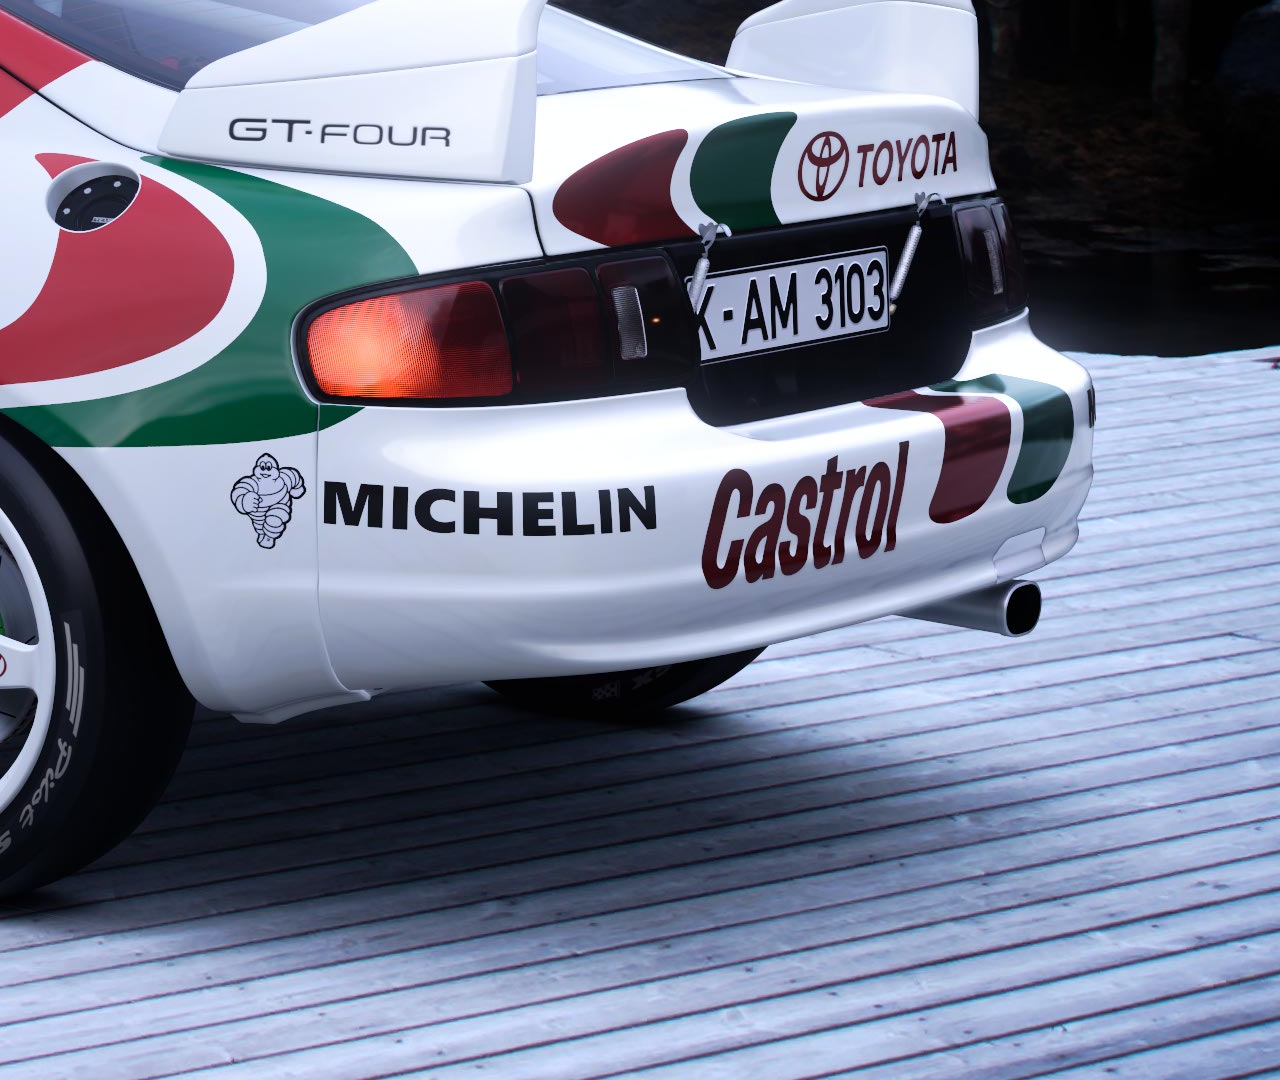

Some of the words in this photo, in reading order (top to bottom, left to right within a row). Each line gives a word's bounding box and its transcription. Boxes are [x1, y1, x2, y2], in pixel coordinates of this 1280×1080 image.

[857, 131, 958, 188] TOYOTA
[815, 258, 885, 331] 3103
[323, 479, 658, 537] MICHELIN
[700, 439, 911, 591] Castrol
[18, 737, 73, 830] Pilot
